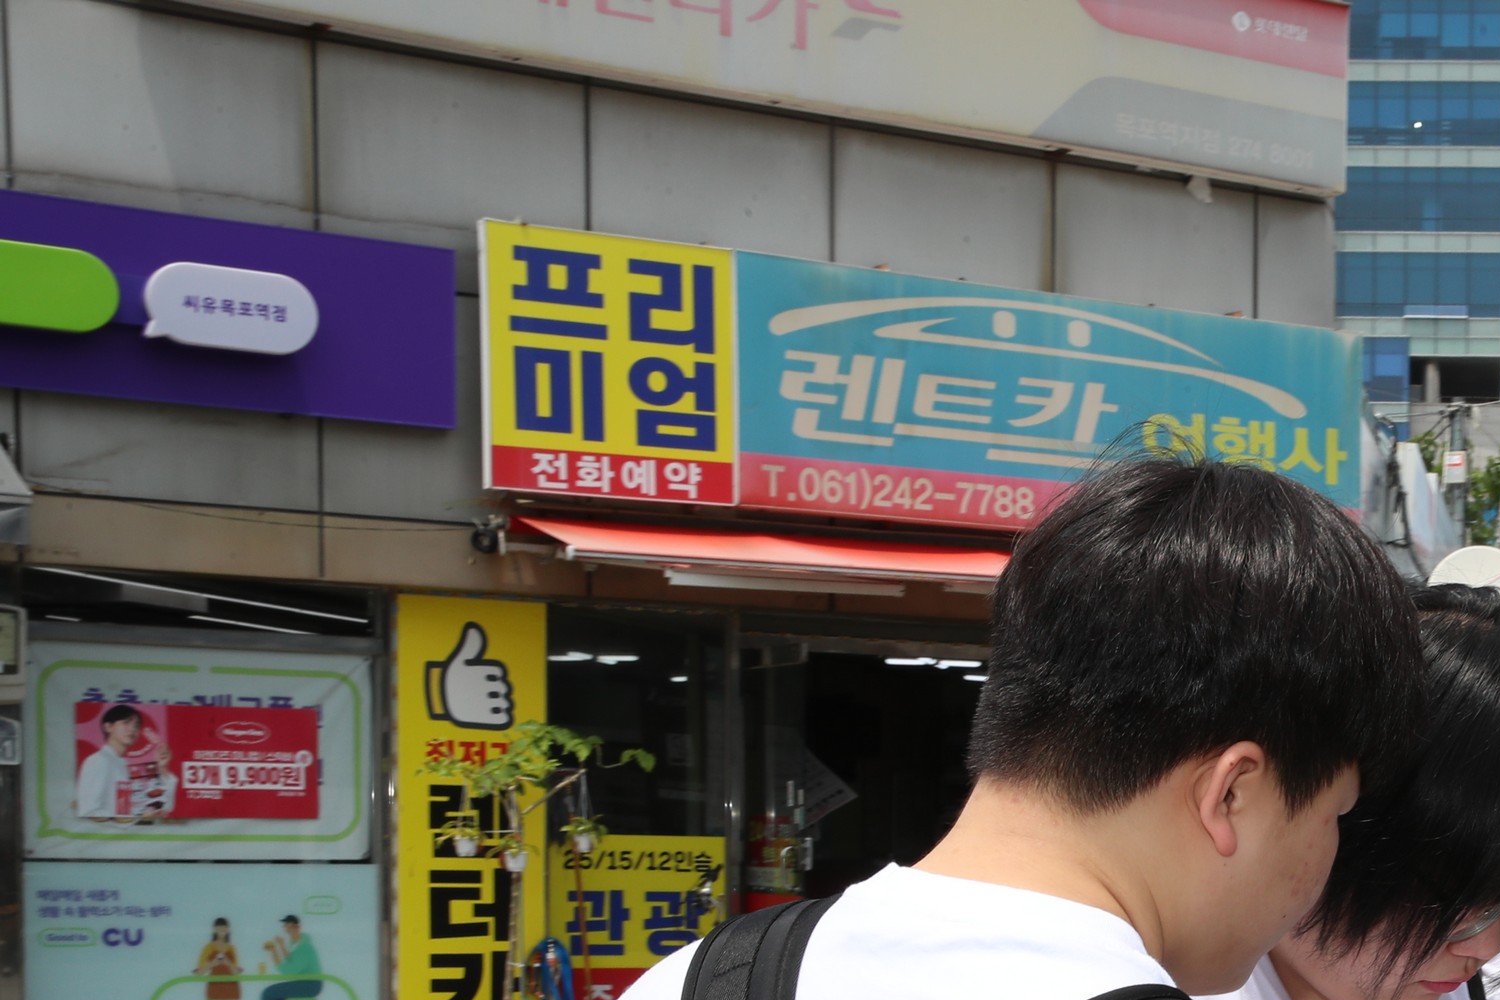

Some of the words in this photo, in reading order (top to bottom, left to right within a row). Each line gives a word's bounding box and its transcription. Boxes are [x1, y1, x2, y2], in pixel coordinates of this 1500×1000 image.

[1115, 112, 1221, 152] 목포역지점
[1228, 136, 1262, 158] 274
[182, 295, 288, 323] 씨유목포역점
[779, 350, 1120, 450] 렌트카
[1143, 413, 1348, 485] 여행사
[425, 738, 512, 769] 최저
[563, 851, 713, 872] 25/15/12인승
[102, 927, 144, 947] CU
